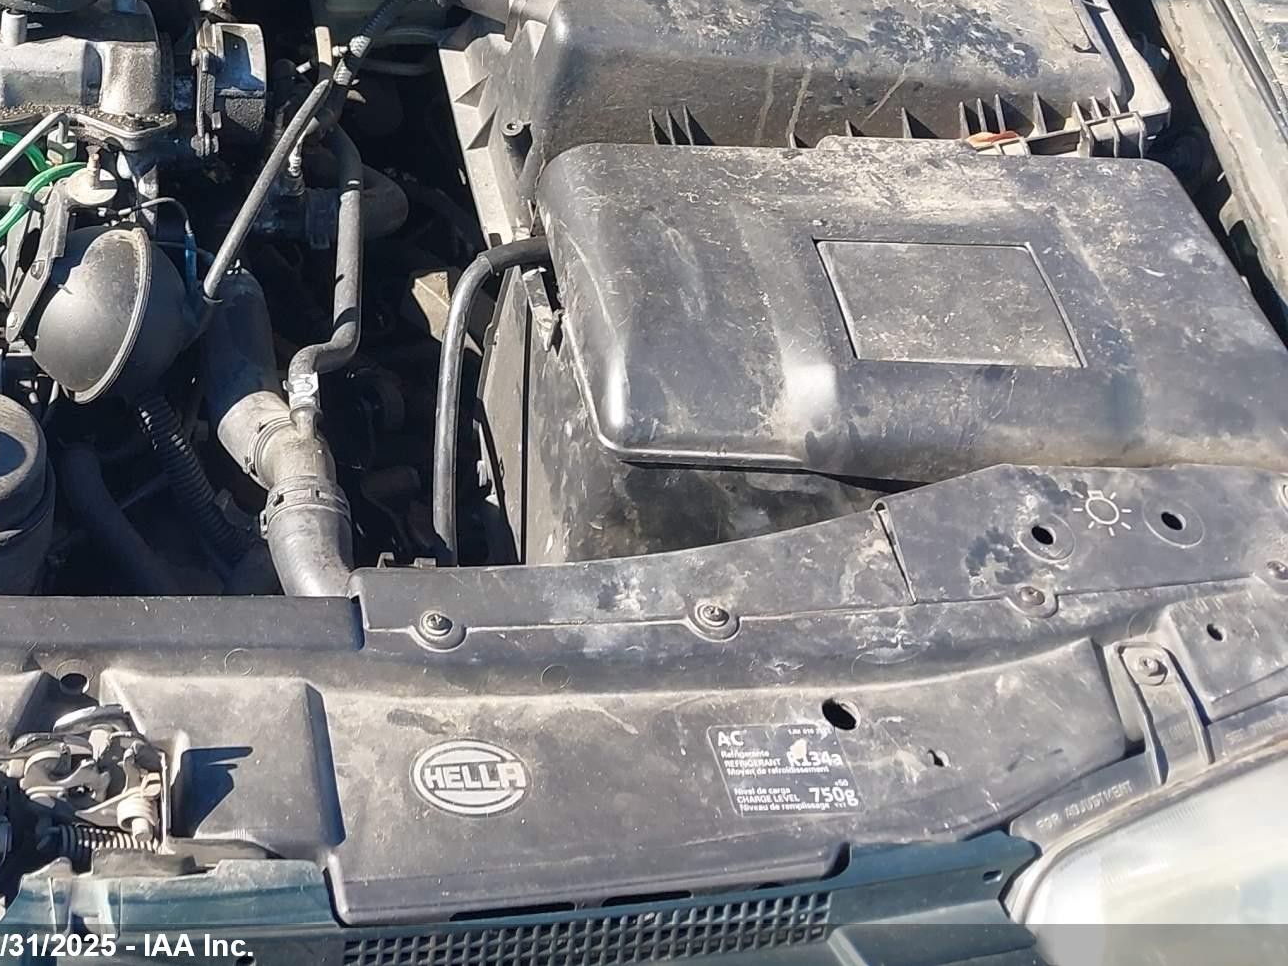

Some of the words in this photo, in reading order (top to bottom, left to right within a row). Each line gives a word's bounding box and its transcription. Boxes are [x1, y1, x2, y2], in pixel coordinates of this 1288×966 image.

[717, 730, 745, 747] AC
[724, 758, 781, 767] REFRIGERANT
[423, 761, 527, 789] HELLA
[768, 766, 830, 775] refroidissement
[733, 787, 755, 795] Nivel
[768, 787, 791, 796] carga
[736, 794, 772, 803] CHARGE
[773, 794, 800, 803] LEVEL
[808, 786, 859, 807] 750g
[739, 803, 769, 811] Niveau
[781, 801, 830, 811] remplissage
